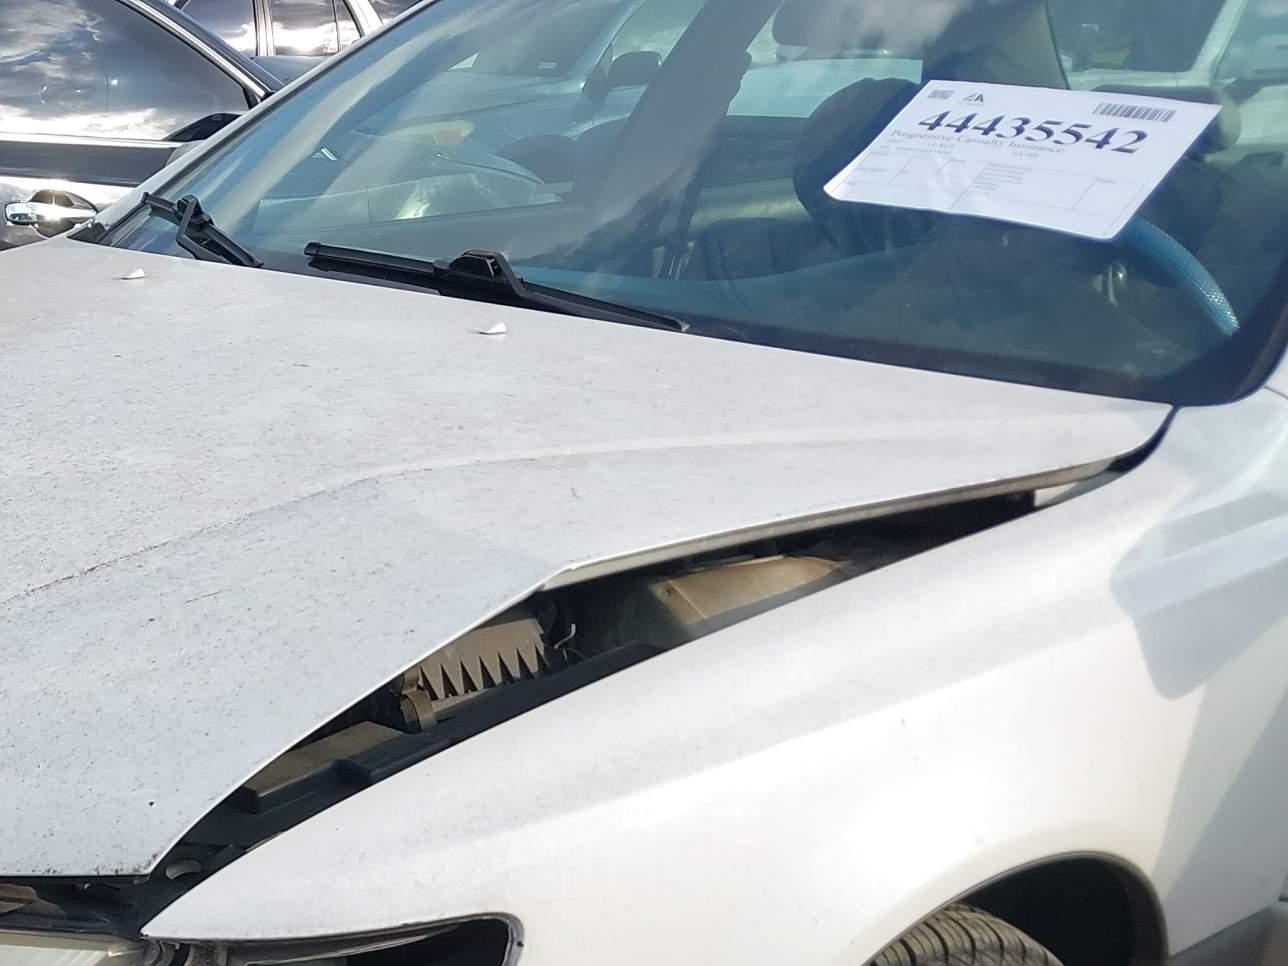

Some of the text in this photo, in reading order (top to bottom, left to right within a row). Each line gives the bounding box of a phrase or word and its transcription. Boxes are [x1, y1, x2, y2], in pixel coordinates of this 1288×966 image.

[892, 130, 951, 142] Progressive
[1009, 141, 1065, 153] Insurance
[918, 110, 1148, 154] 44435542
